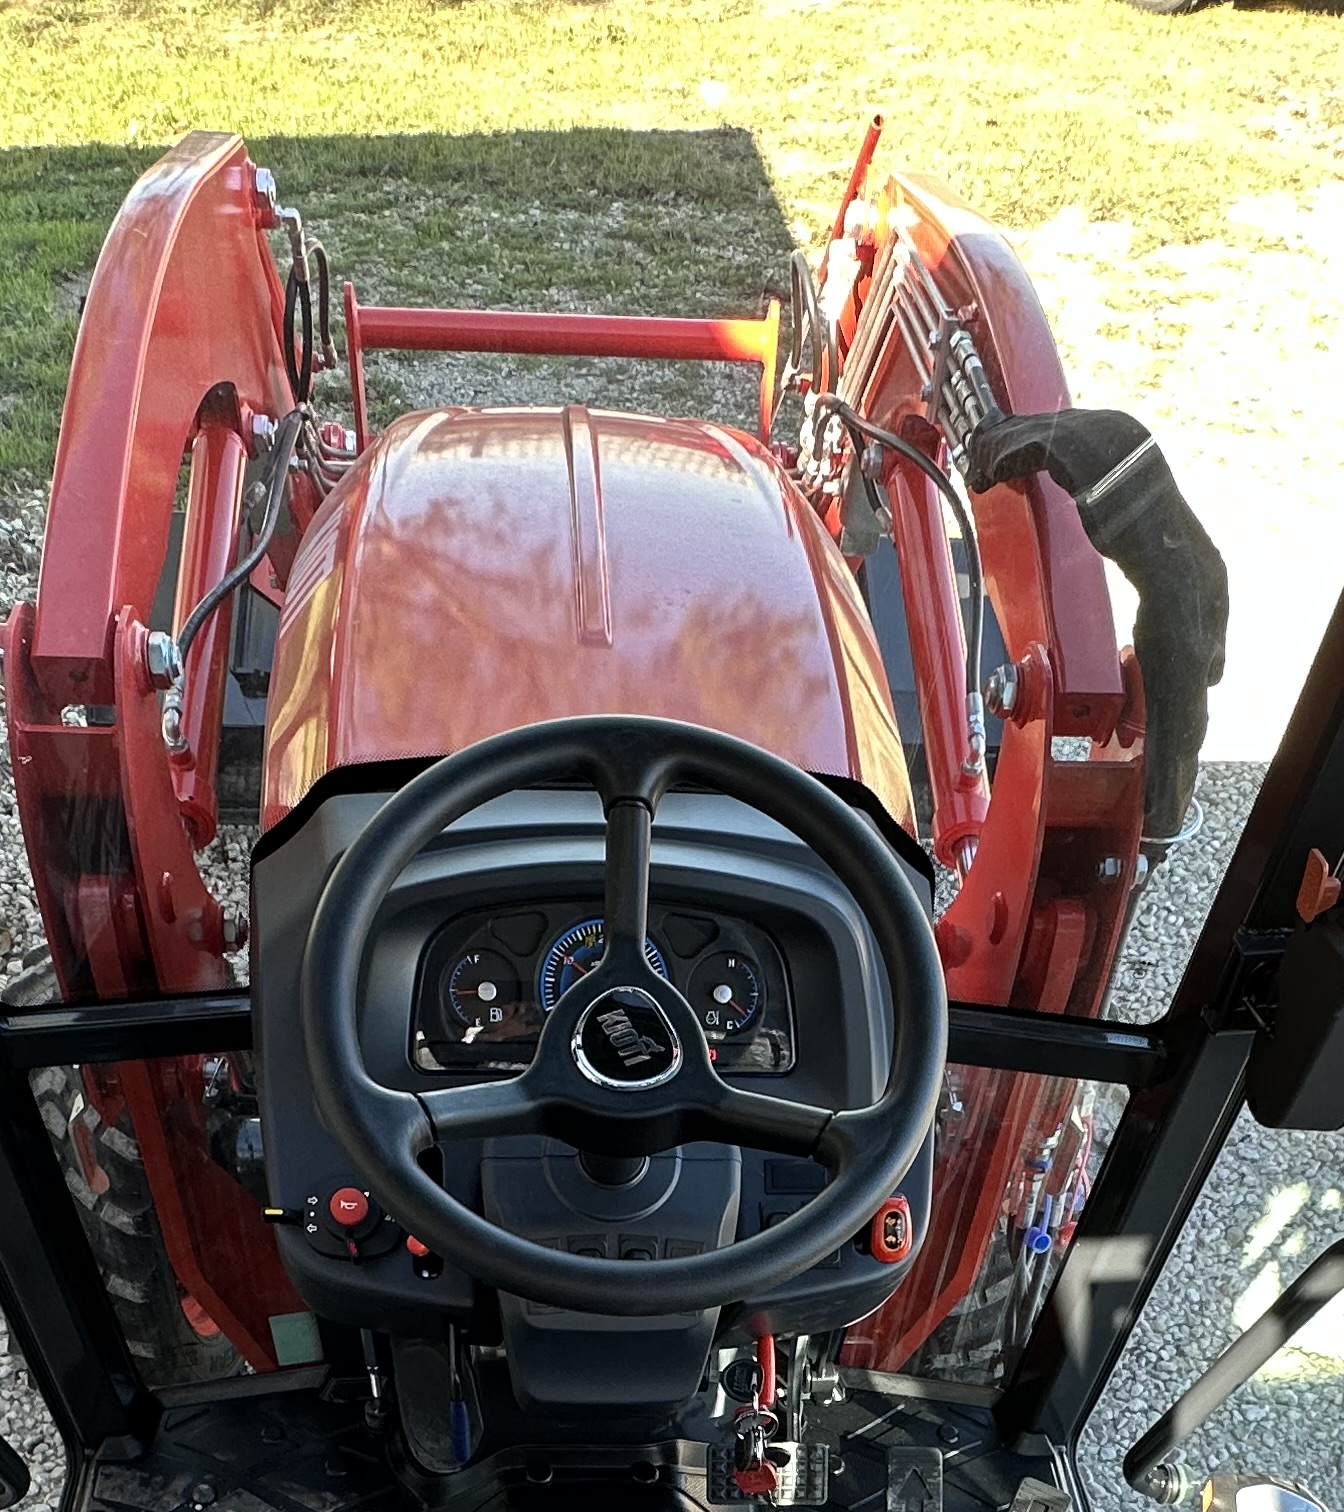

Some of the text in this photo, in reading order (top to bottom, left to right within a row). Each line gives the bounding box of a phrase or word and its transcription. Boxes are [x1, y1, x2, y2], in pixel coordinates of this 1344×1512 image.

[473, 954, 480, 964] F
[727, 958, 735, 968] H
[475, 1017, 481, 1026] E
[726, 1020, 733, 1030] C
[596, 1008, 653, 1068] KIOTI
